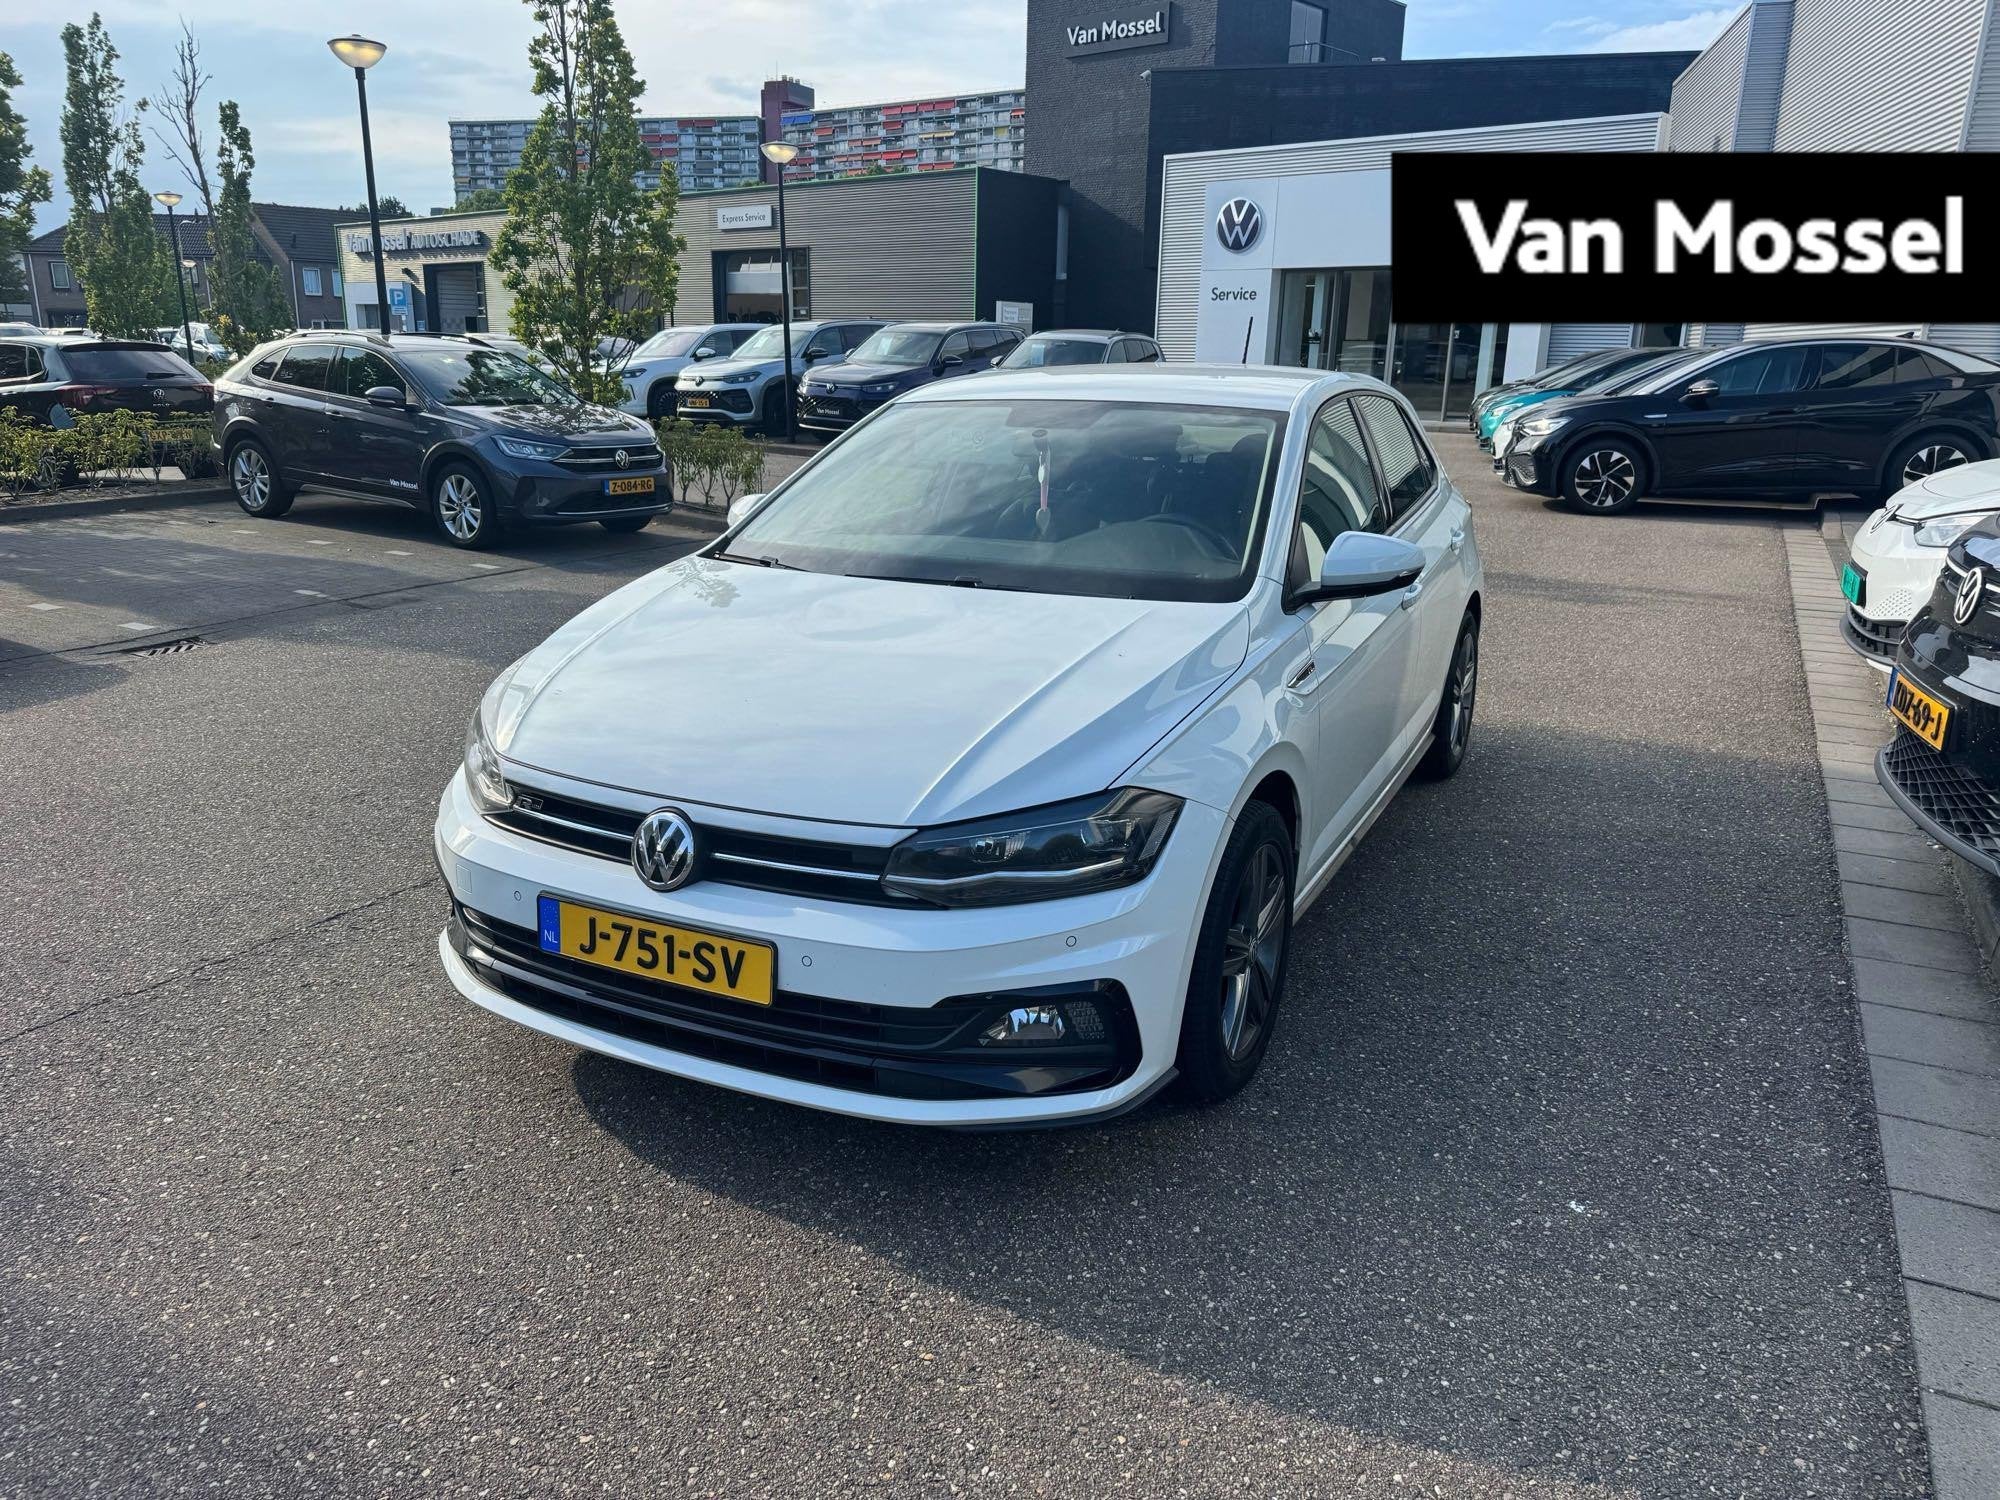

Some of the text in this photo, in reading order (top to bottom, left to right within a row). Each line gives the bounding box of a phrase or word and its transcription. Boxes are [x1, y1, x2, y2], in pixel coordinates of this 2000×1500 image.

[1067, 11, 1161, 45] Van Mossel
[722, 212, 766, 223] Express Service
[347, 234, 368, 252] Van
[411, 230, 481, 249] AUTOSCHADE
[394, 290, 404, 305] P
[1211, 287, 1257, 301] Service
[390, 478, 418, 489] Van Mossel
[611, 479, 652, 493] Z-084-RG
[544, 928, 558, 944] NL
[579, 916, 746, 989] J-751-SV
